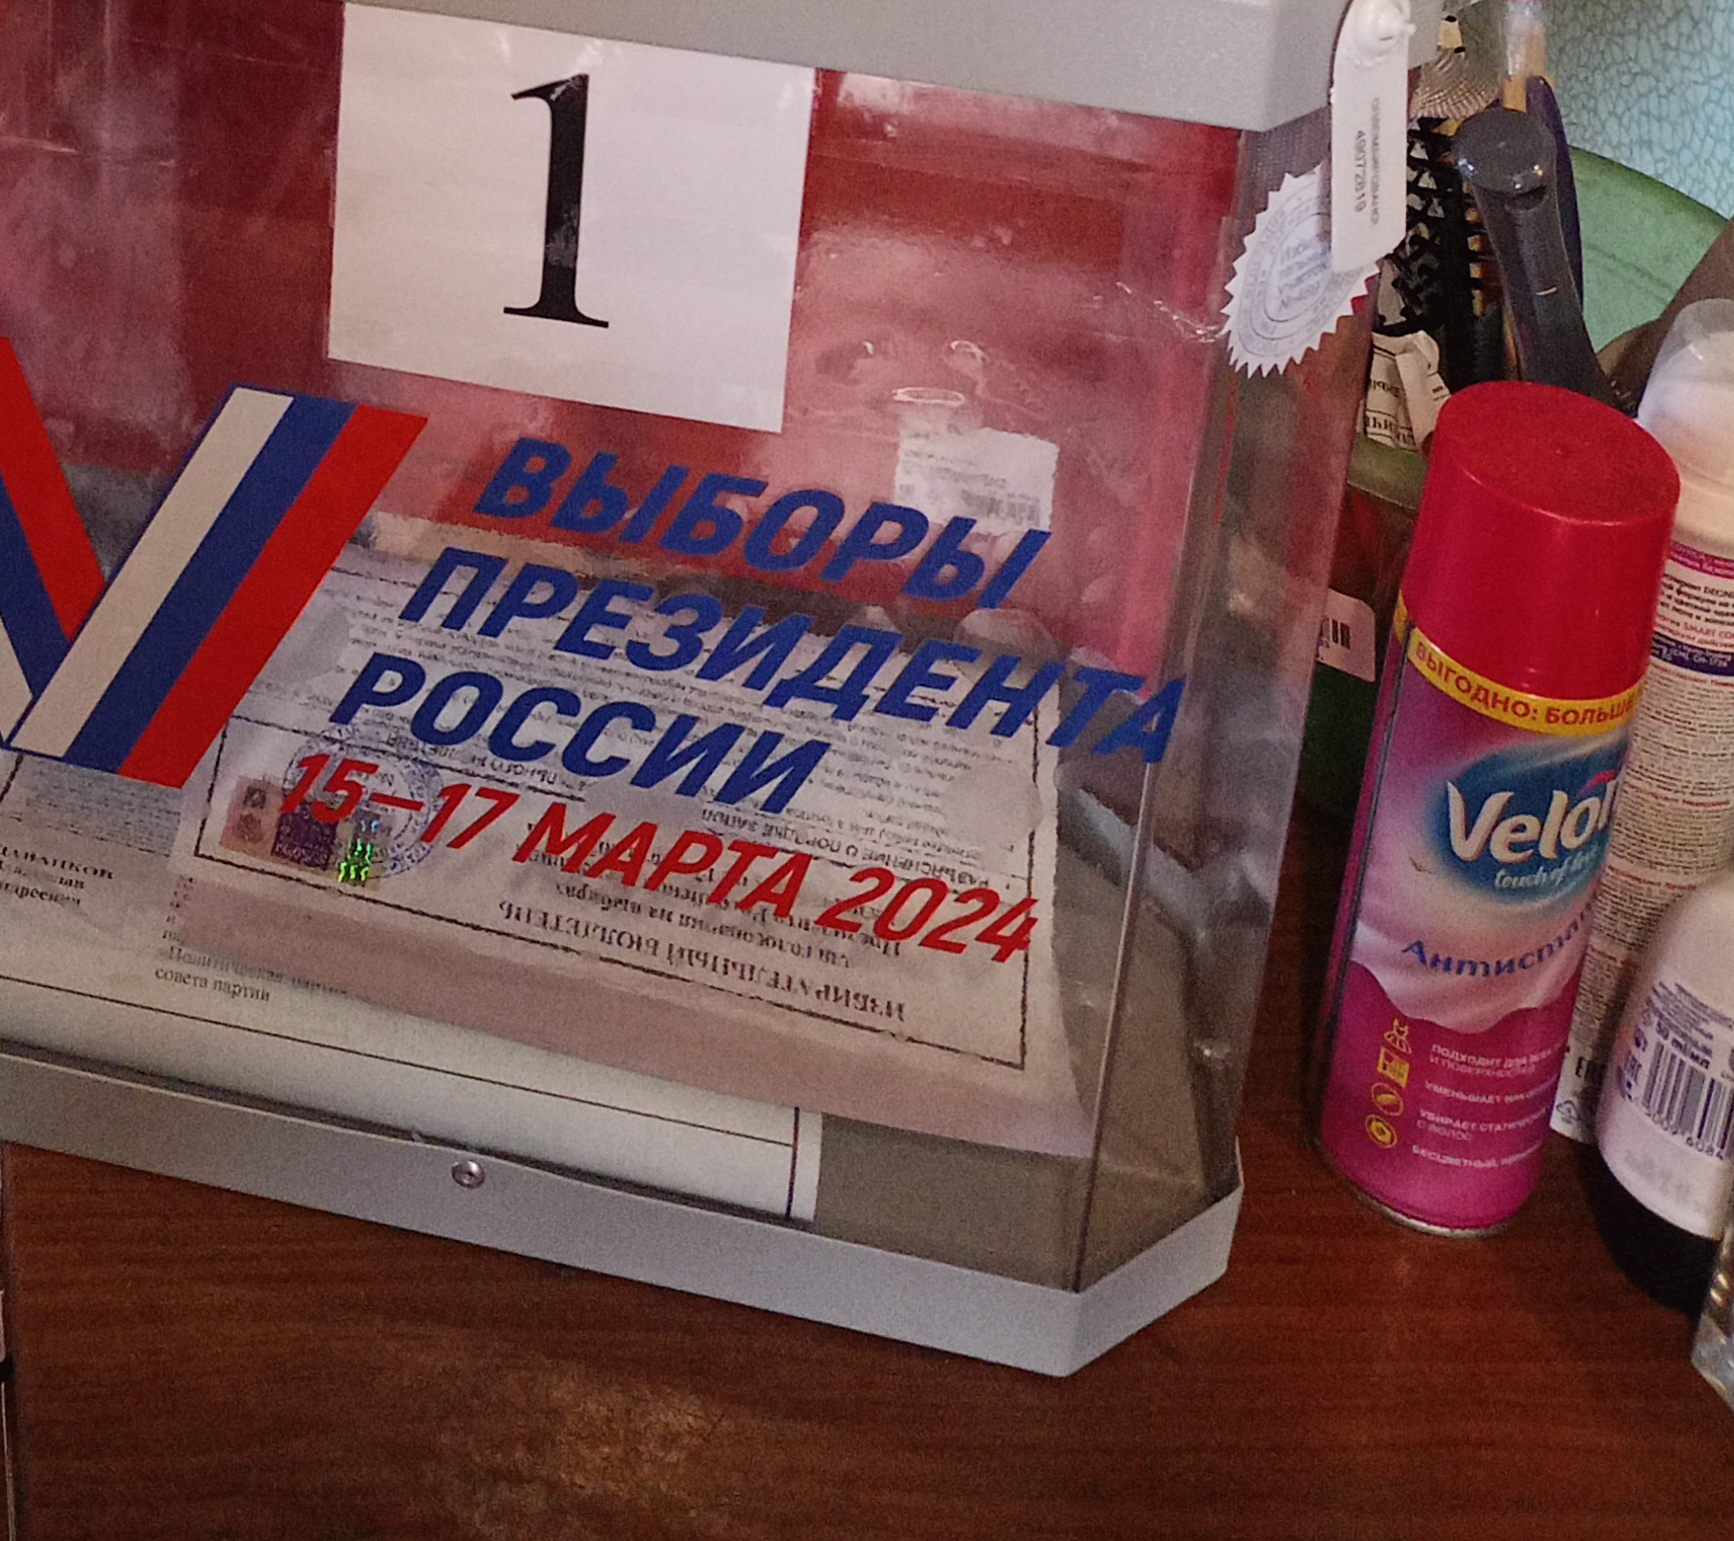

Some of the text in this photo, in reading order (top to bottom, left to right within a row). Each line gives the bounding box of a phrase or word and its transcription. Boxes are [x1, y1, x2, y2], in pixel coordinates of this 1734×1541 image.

[503, 72, 611, 330] 1
[472, 437, 1050, 609] ВЫБОРЫ
[332, 653, 830, 815] РОССИИ
[400, 546, 1188, 764] ПРЕЗИДЕНТА
[1416, 641, 1538, 721] ВЫГОДНО:
[514, 799, 813, 920] МАРТА
[814, 867, 1040, 964] 2024
